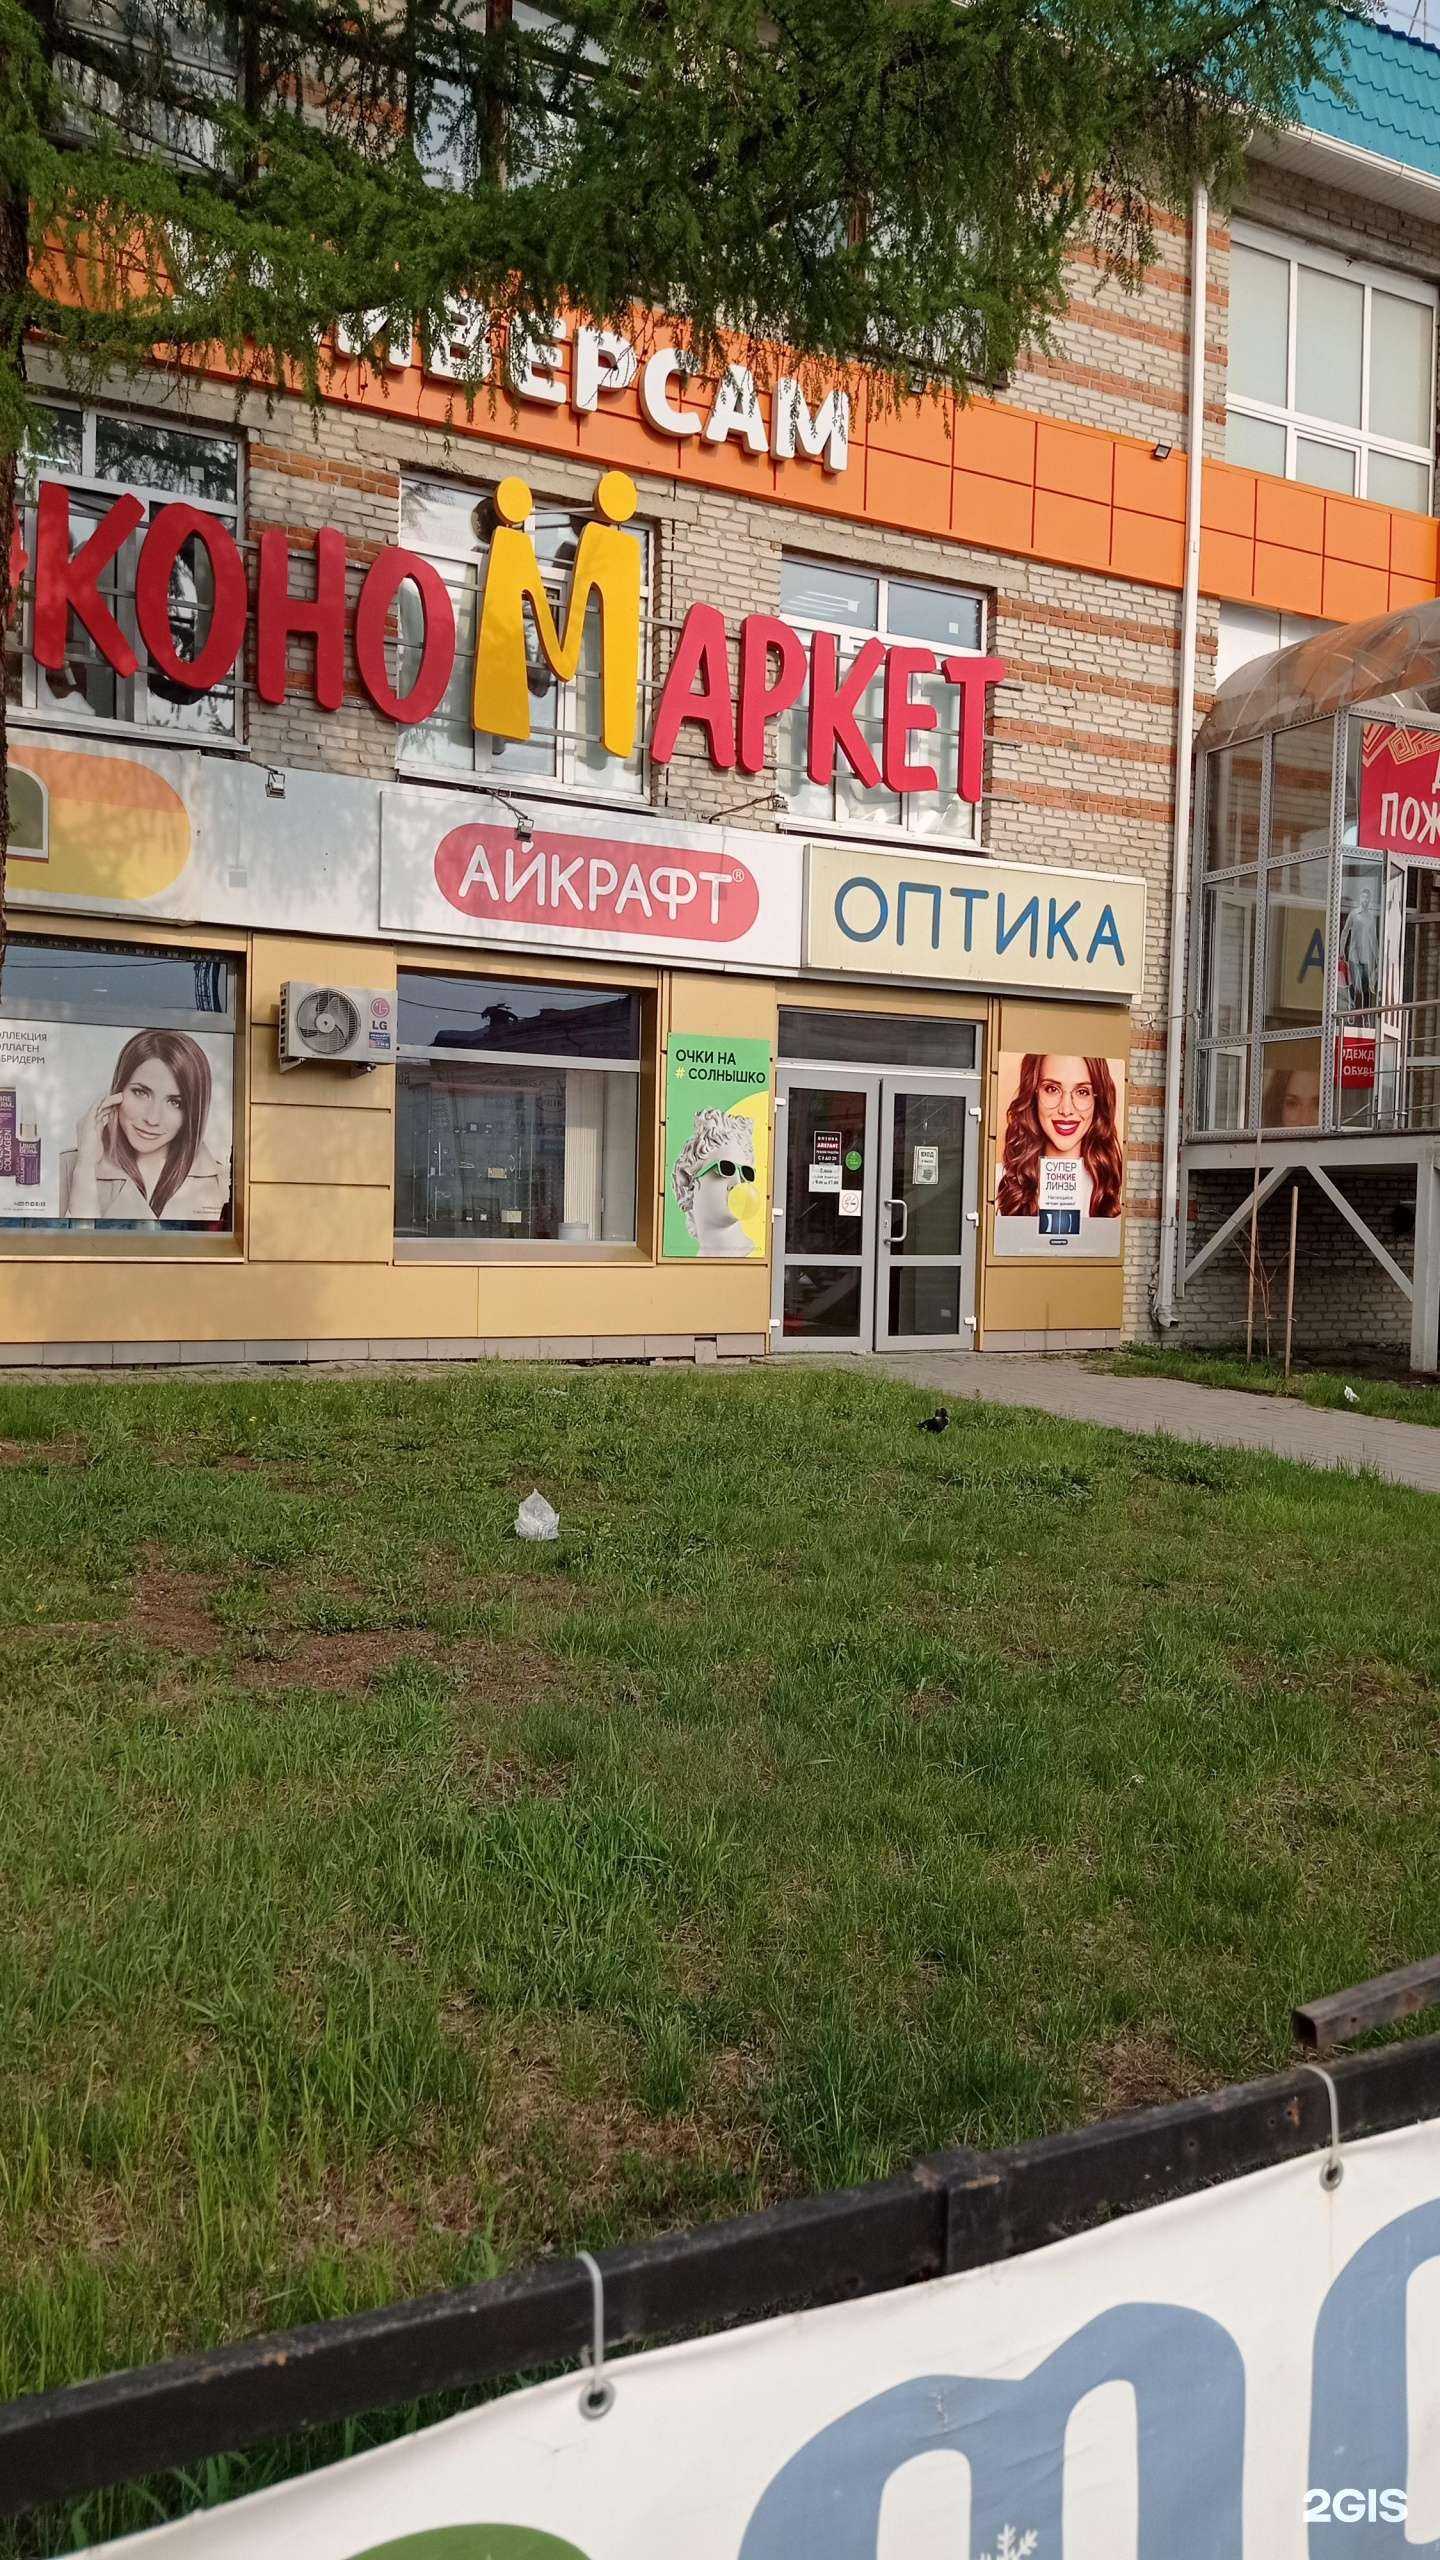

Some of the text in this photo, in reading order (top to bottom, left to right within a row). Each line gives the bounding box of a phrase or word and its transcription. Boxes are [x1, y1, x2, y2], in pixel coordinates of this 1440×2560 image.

[8, 470, 1006, 804] КОНОМАРКЕТ
[833, 876, 1126, 967] ОПТИКА
[372, 1020, 388, 1031] LG
[0, 1031, 48, 1042] ЛЛЕКЦИЯ
[0, 1043, 40, 1053] ЛЛАГЕН
[675, 1049, 737, 1065] ОЧКИ НА
[1045, 1161, 1078, 1173] СУПЕР
[1046, 1172, 1077, 1182] ТОНКИЕ
[1045, 1181, 1077, 1192] ЛИНЗЫ
